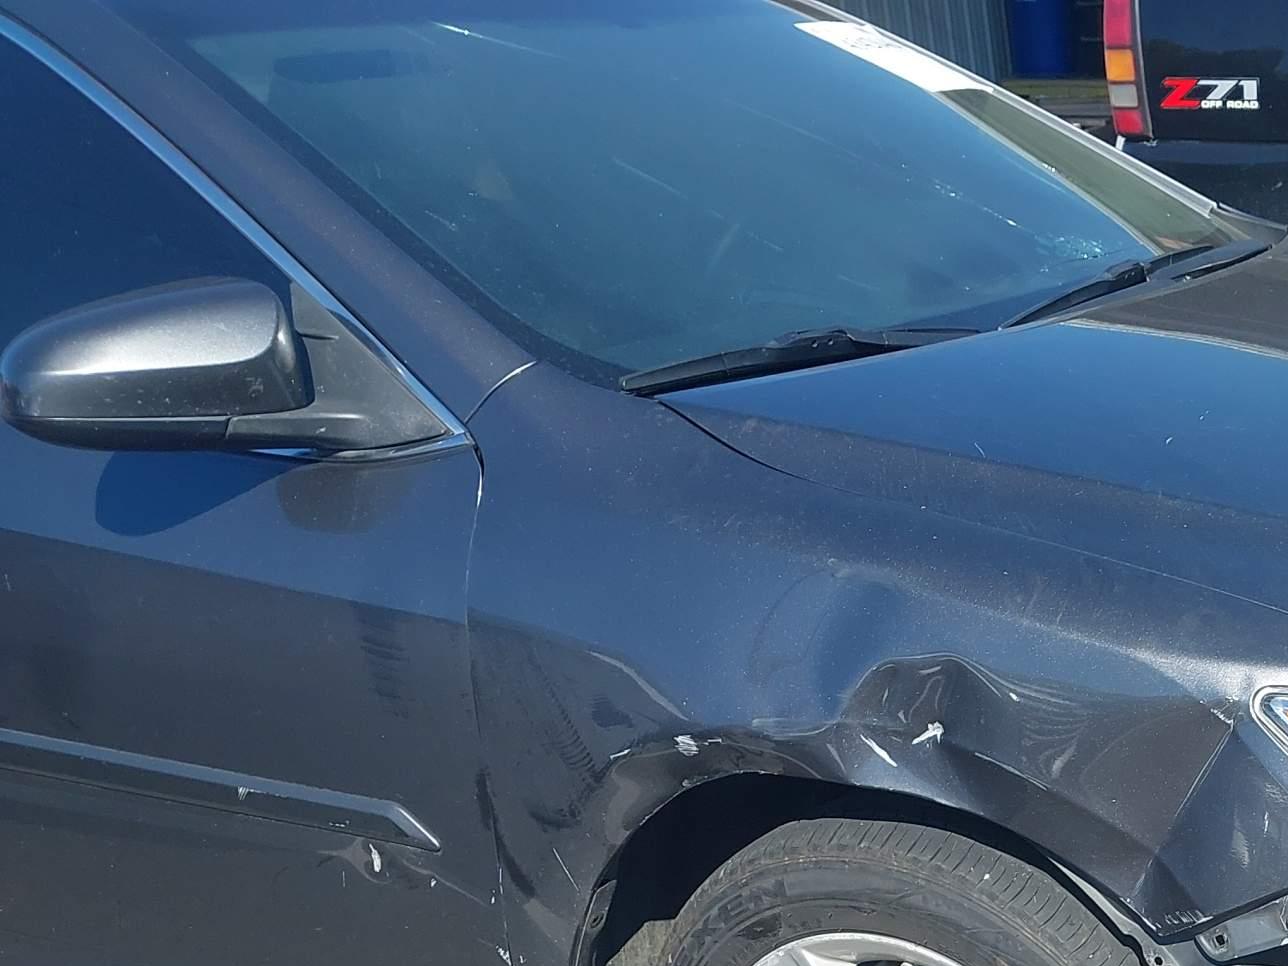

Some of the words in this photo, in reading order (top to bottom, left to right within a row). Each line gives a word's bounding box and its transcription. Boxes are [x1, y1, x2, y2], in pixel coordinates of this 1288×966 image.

[1161, 78, 1258, 108] Z71
[1200, 100, 1222, 109] OFF
[1226, 100, 1259, 109] ROAD
